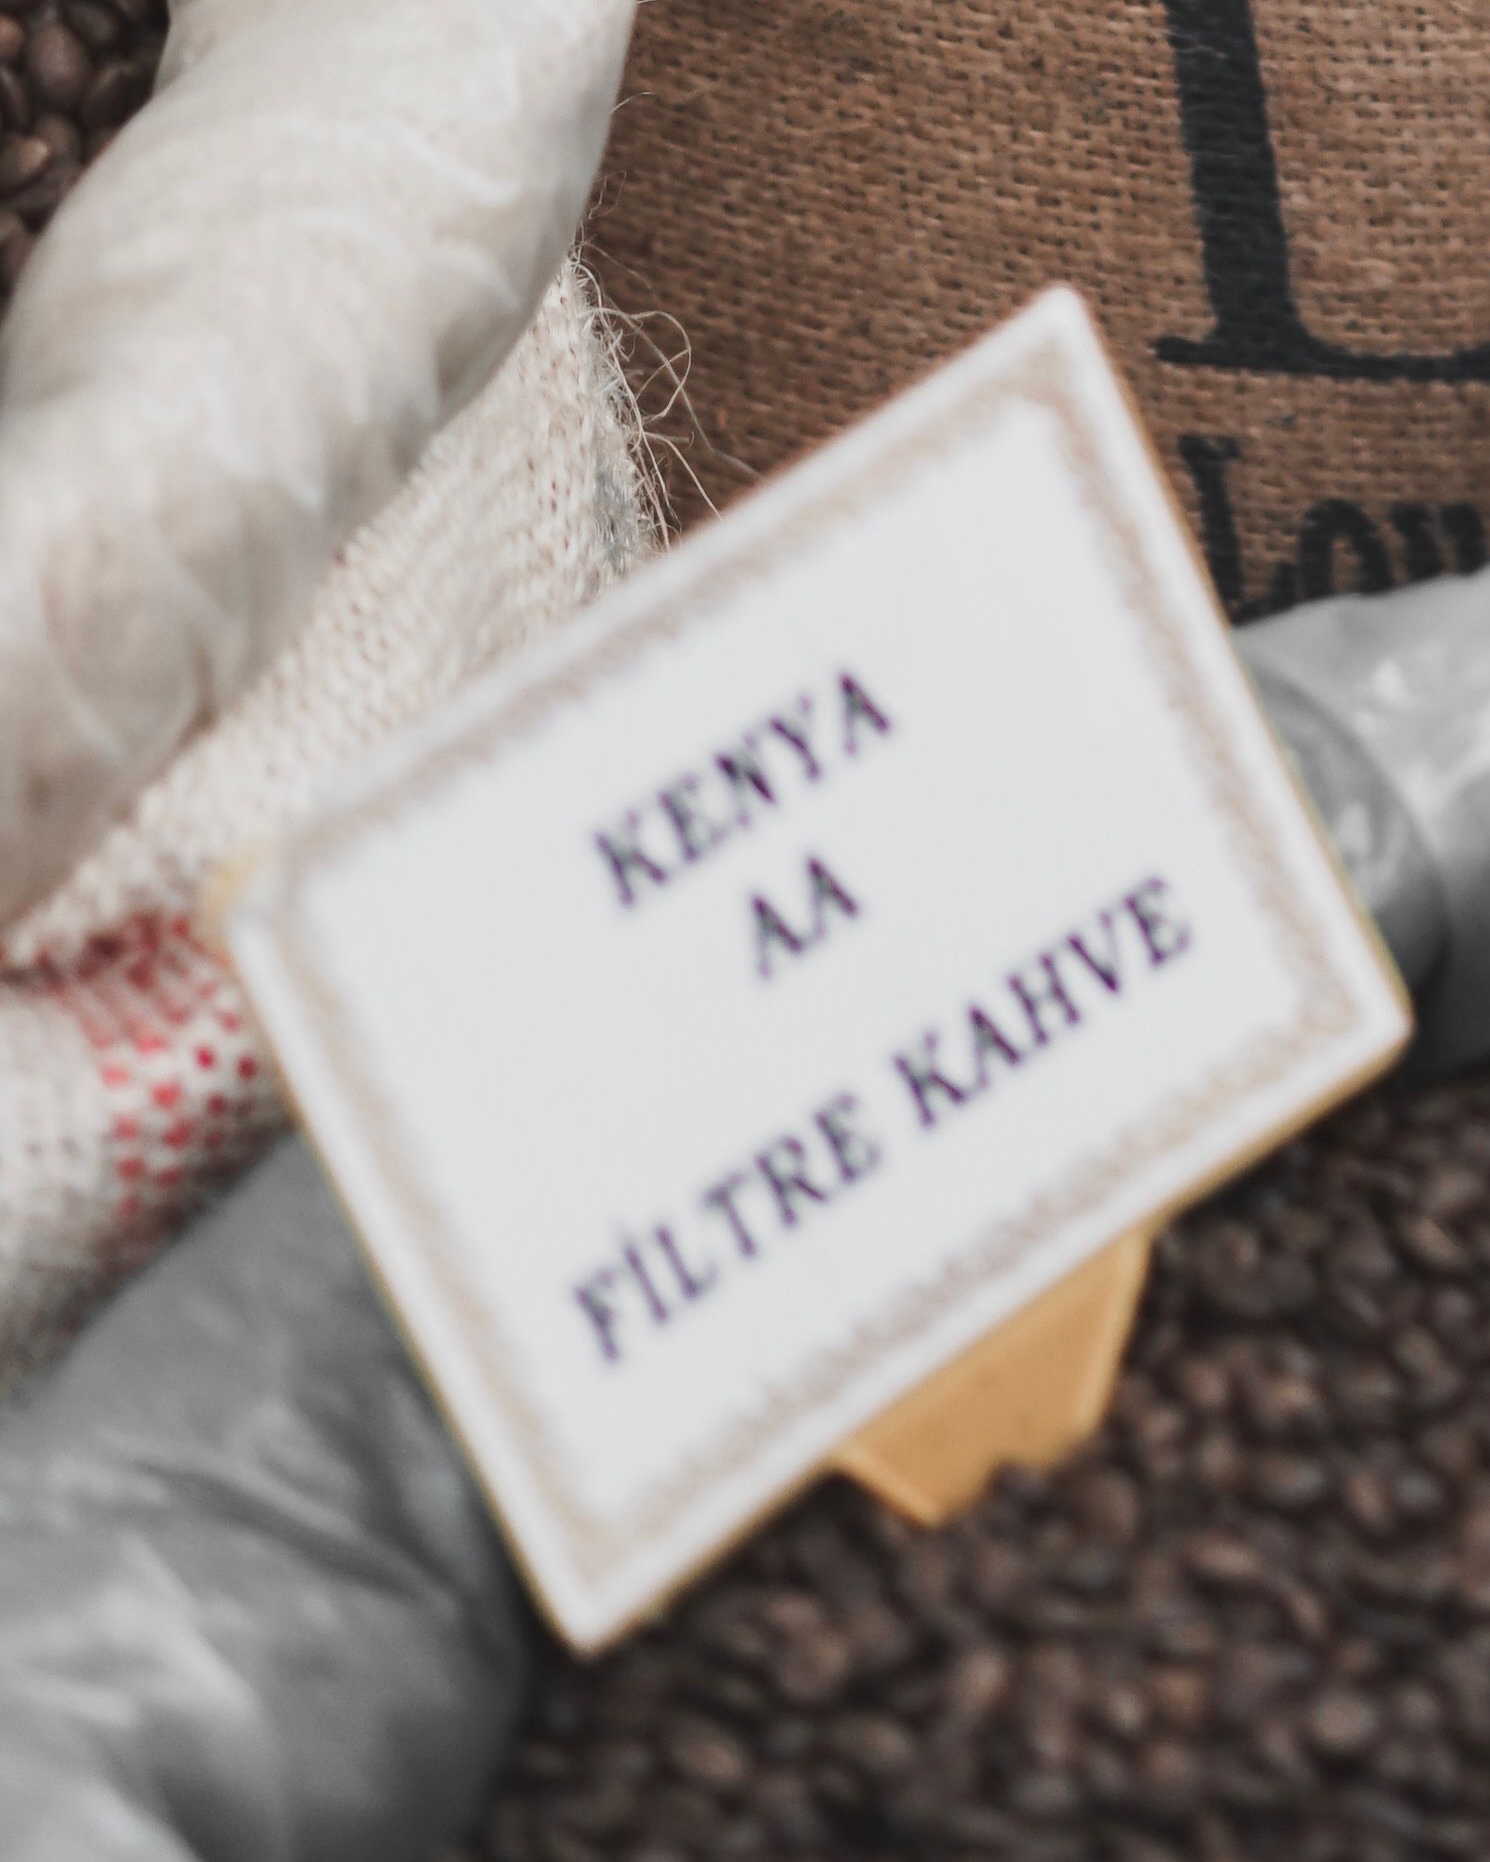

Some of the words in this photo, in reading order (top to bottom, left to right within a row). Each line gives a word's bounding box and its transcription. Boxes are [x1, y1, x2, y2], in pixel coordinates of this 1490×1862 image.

[592, 669, 896, 910] KENYA
[745, 854, 863, 980] AA
[888, 873, 1197, 1132] KAHVE
